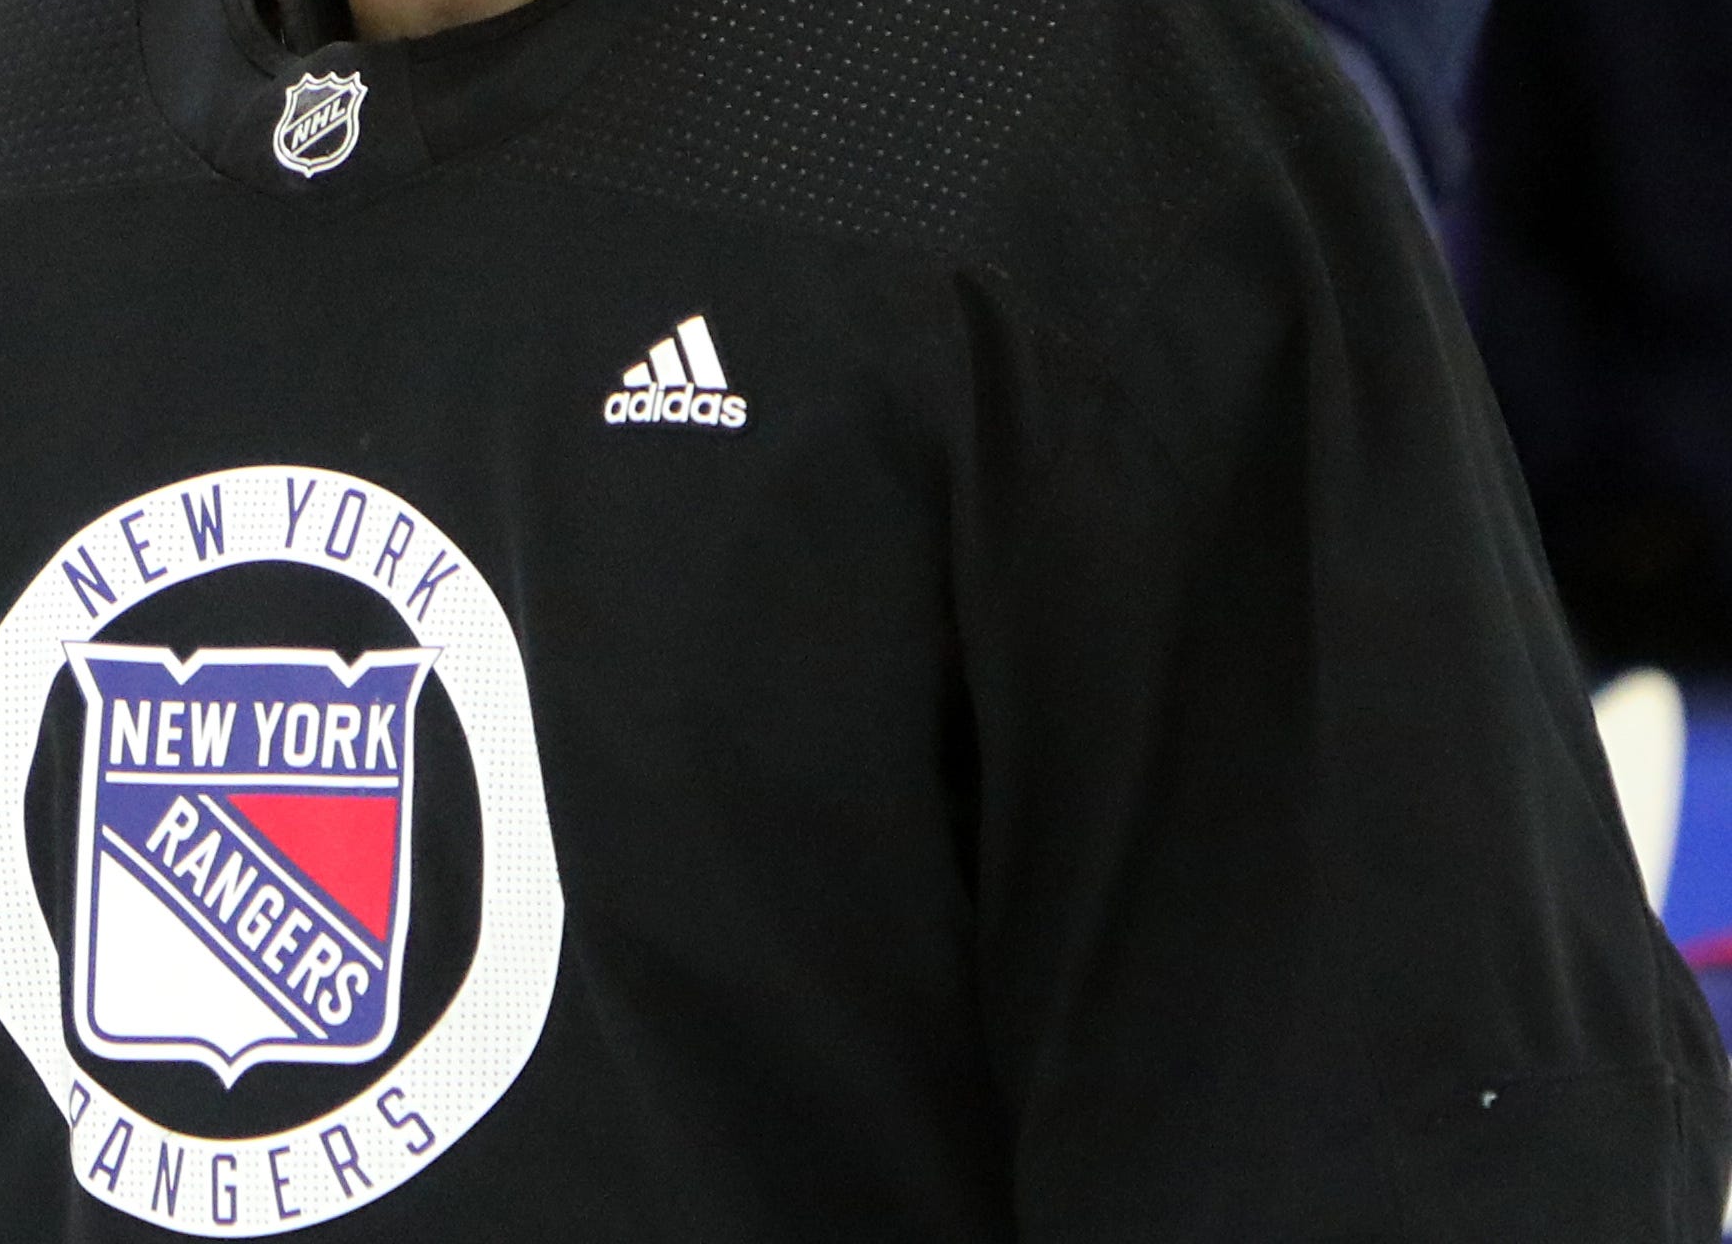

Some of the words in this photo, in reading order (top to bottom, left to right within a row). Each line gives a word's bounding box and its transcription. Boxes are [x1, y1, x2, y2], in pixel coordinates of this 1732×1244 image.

[291, 97, 346, 150] NHL
[605, 382, 747, 429] adidas
[62, 484, 225, 618] NEW
[285, 478, 460, 622] YORK
[109, 700, 235, 768] NEW
[252, 702, 398, 769] YORK
[146, 795, 370, 1026] RANGERS
